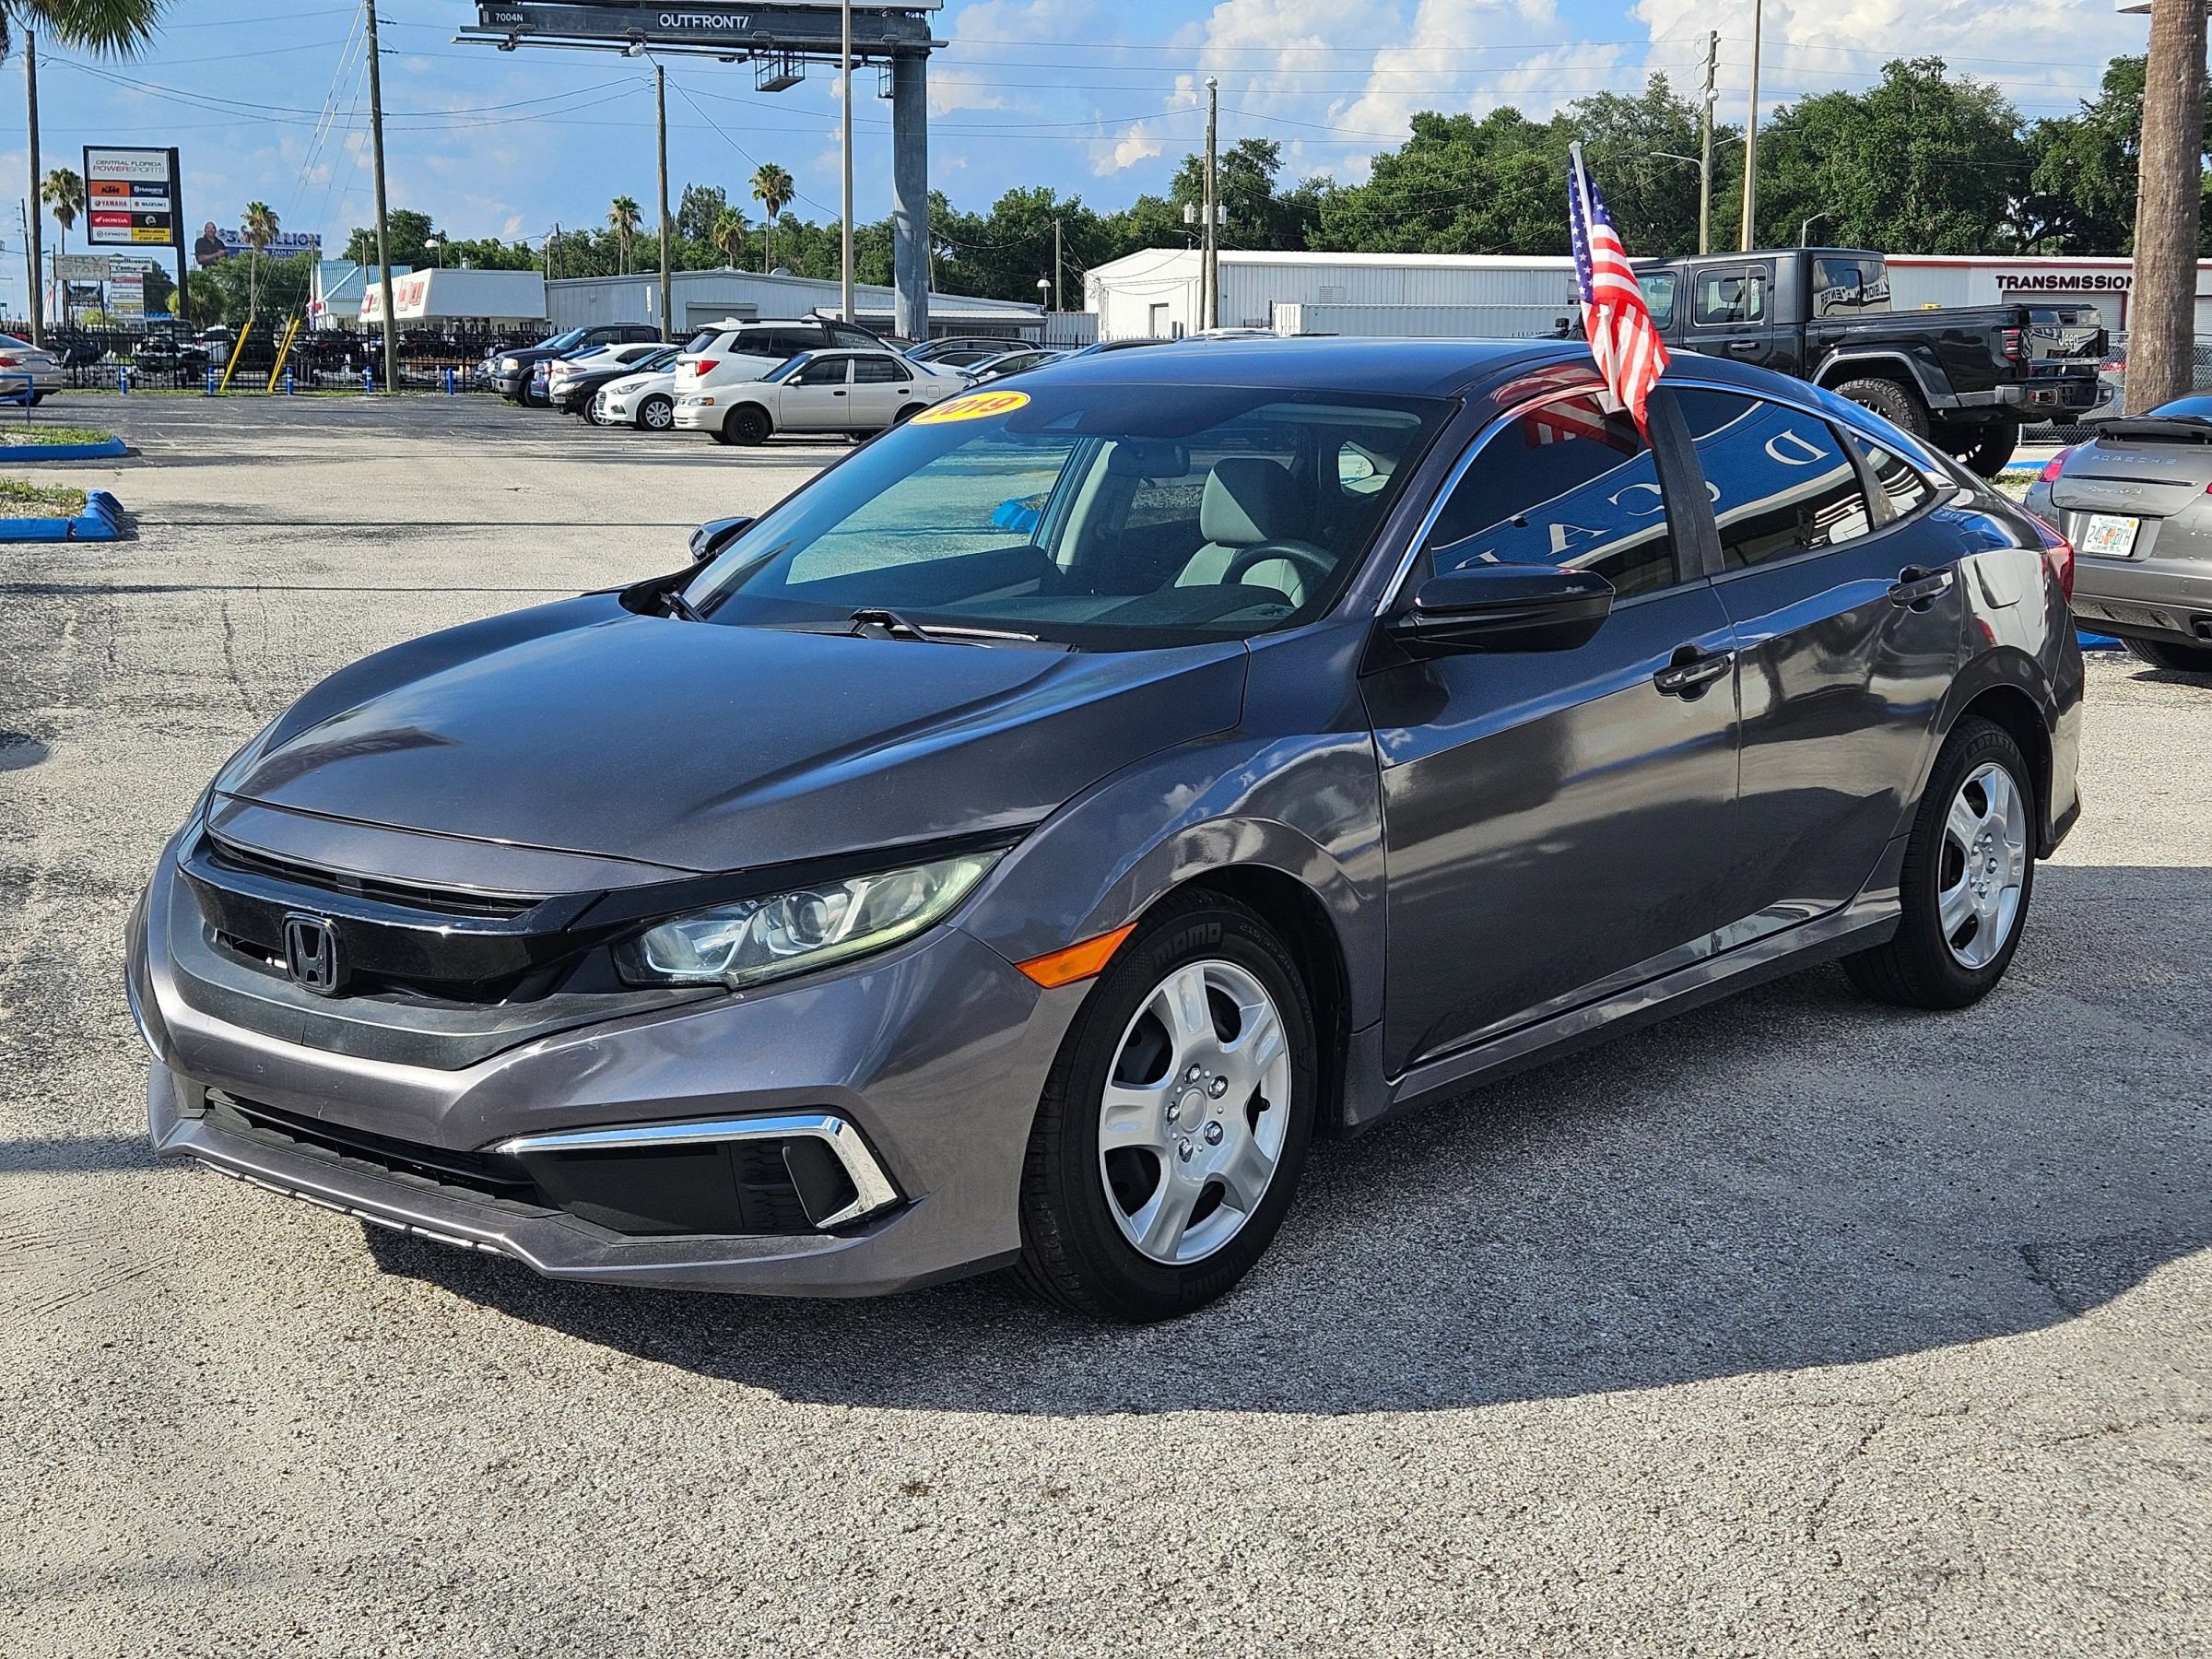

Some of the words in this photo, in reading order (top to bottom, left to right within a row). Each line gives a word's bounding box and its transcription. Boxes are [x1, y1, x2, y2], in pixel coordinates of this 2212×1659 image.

[495, 13, 524, 23] 7004N
[92, 165, 165, 173] POWERSPORTS
[100, 185, 120, 194] KTM
[268, 232, 322, 247] ILLION
[62, 265, 103, 273] STAR
[2058, 330, 2078, 349] Jeep
[925, 396, 1020, 417] 2019
